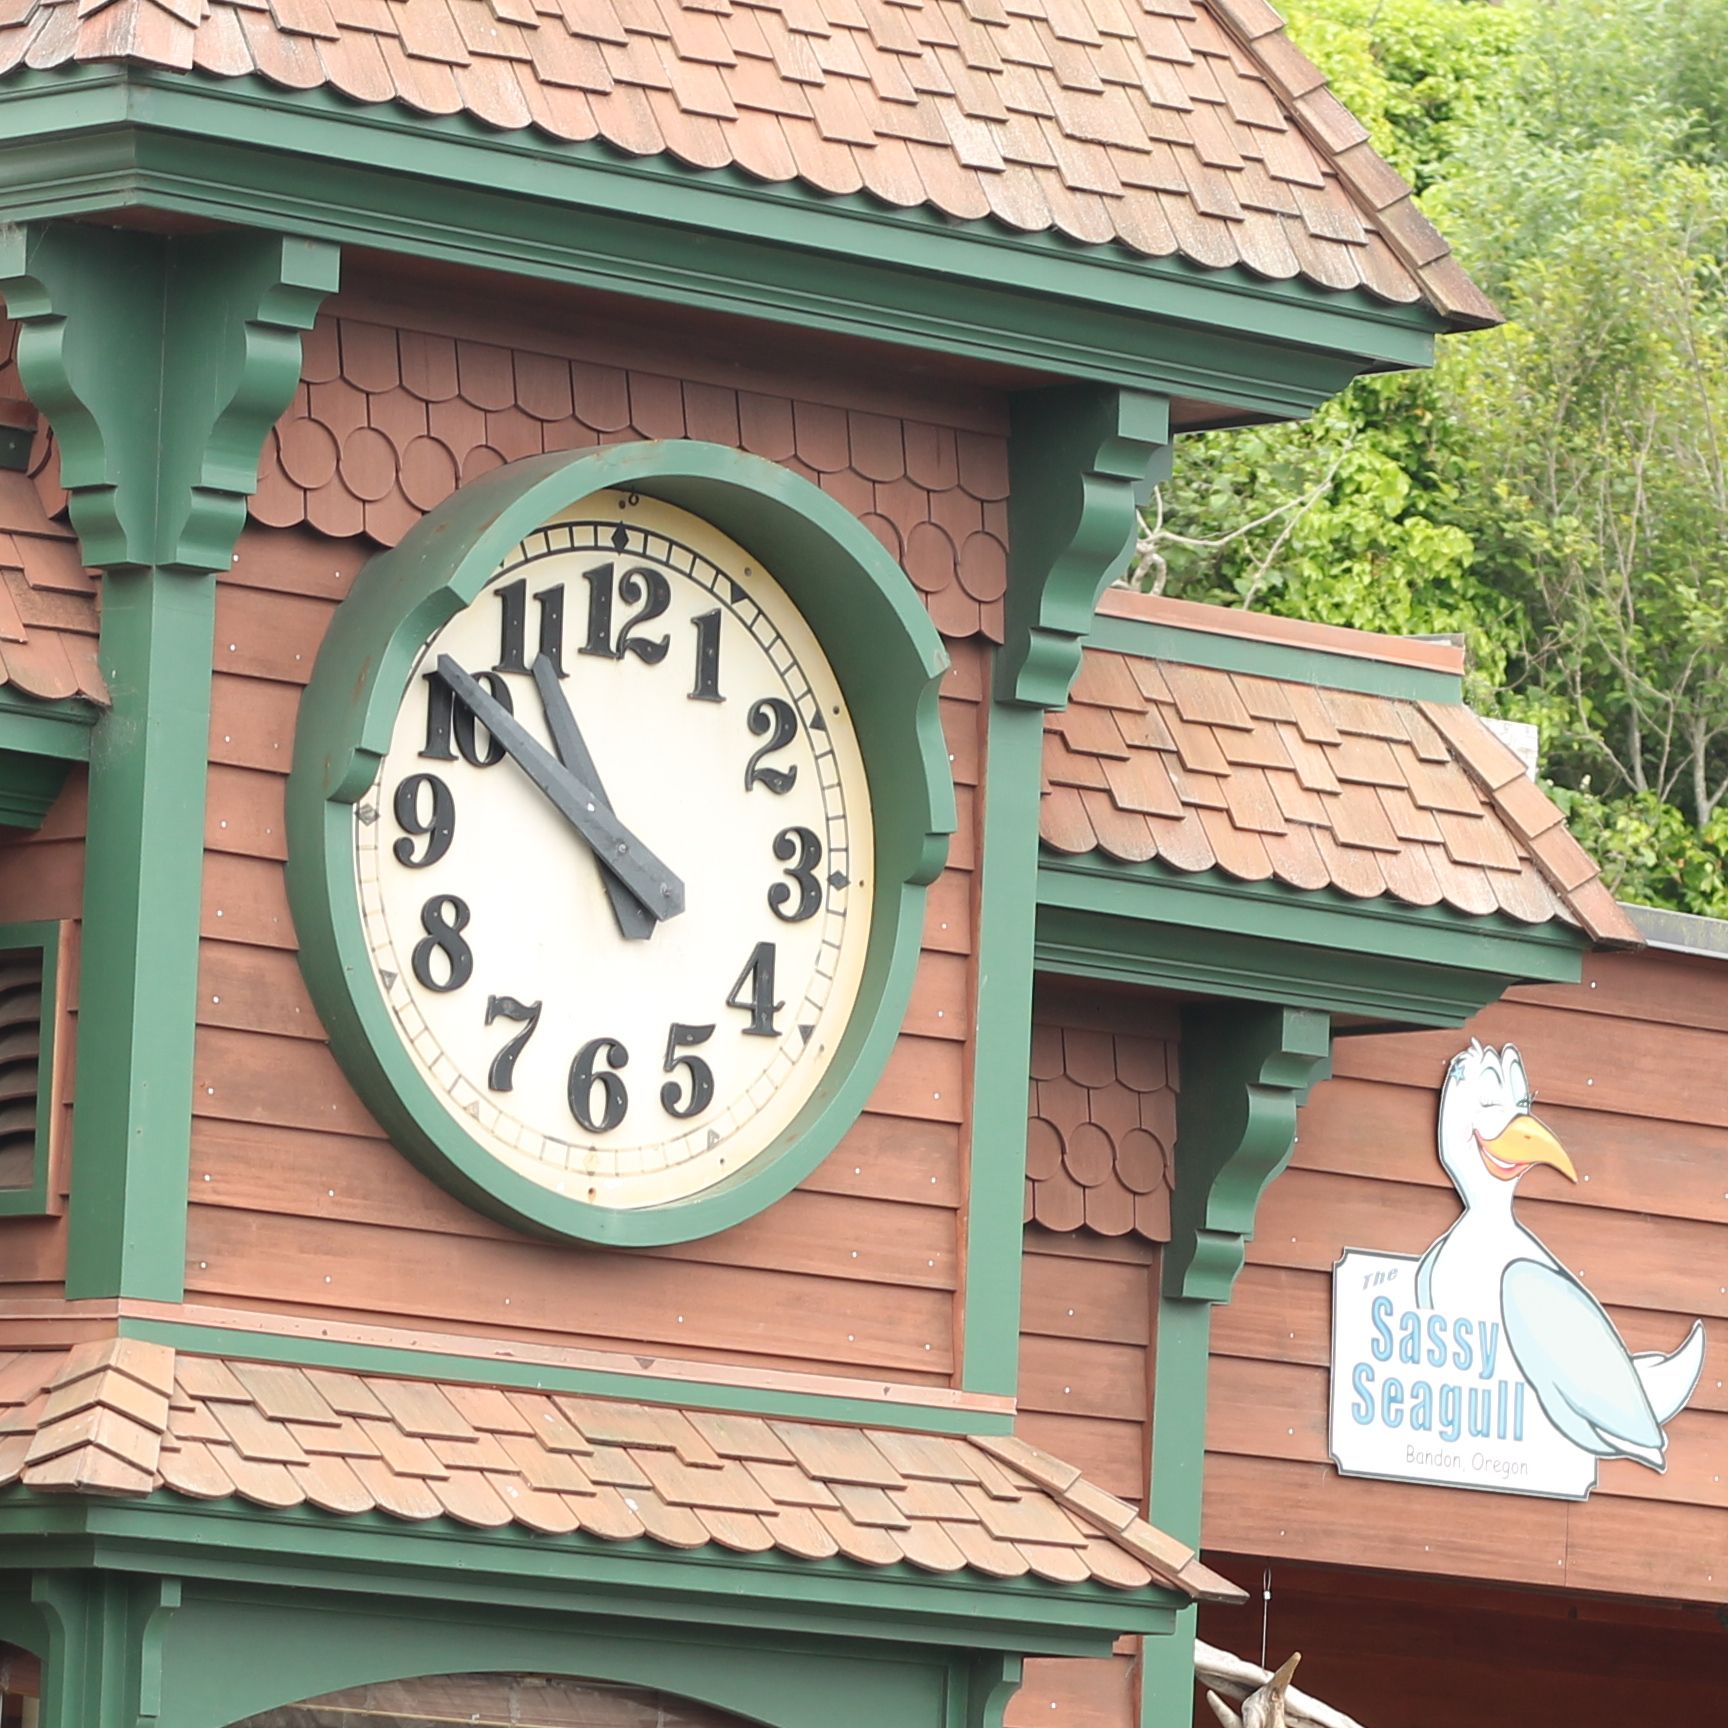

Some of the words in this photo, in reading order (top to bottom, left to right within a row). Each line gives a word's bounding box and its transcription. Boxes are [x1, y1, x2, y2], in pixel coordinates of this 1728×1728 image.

[493, 577, 569, 680] 11
[578, 562, 672, 666] 12
[687, 607, 726, 704] 1
[418, 667, 513, 769] 10
[746, 697, 798, 795] 2
[392, 773, 456, 868] 9
[768, 826, 823, 923] 3
[411, 894, 473, 992] 8
[726, 941, 783, 1037] 4
[484, 995, 542, 1092] 7
[567, 1038, 629, 1134] 6
[660, 1022, 716, 1119] 5
[1362, 1265, 1399, 1290] The
[1371, 1295, 1500, 1380] Sassy
[1351, 1363, 1525, 1442] Seagull
[1472, 1452, 1529, 1479] Oregon
